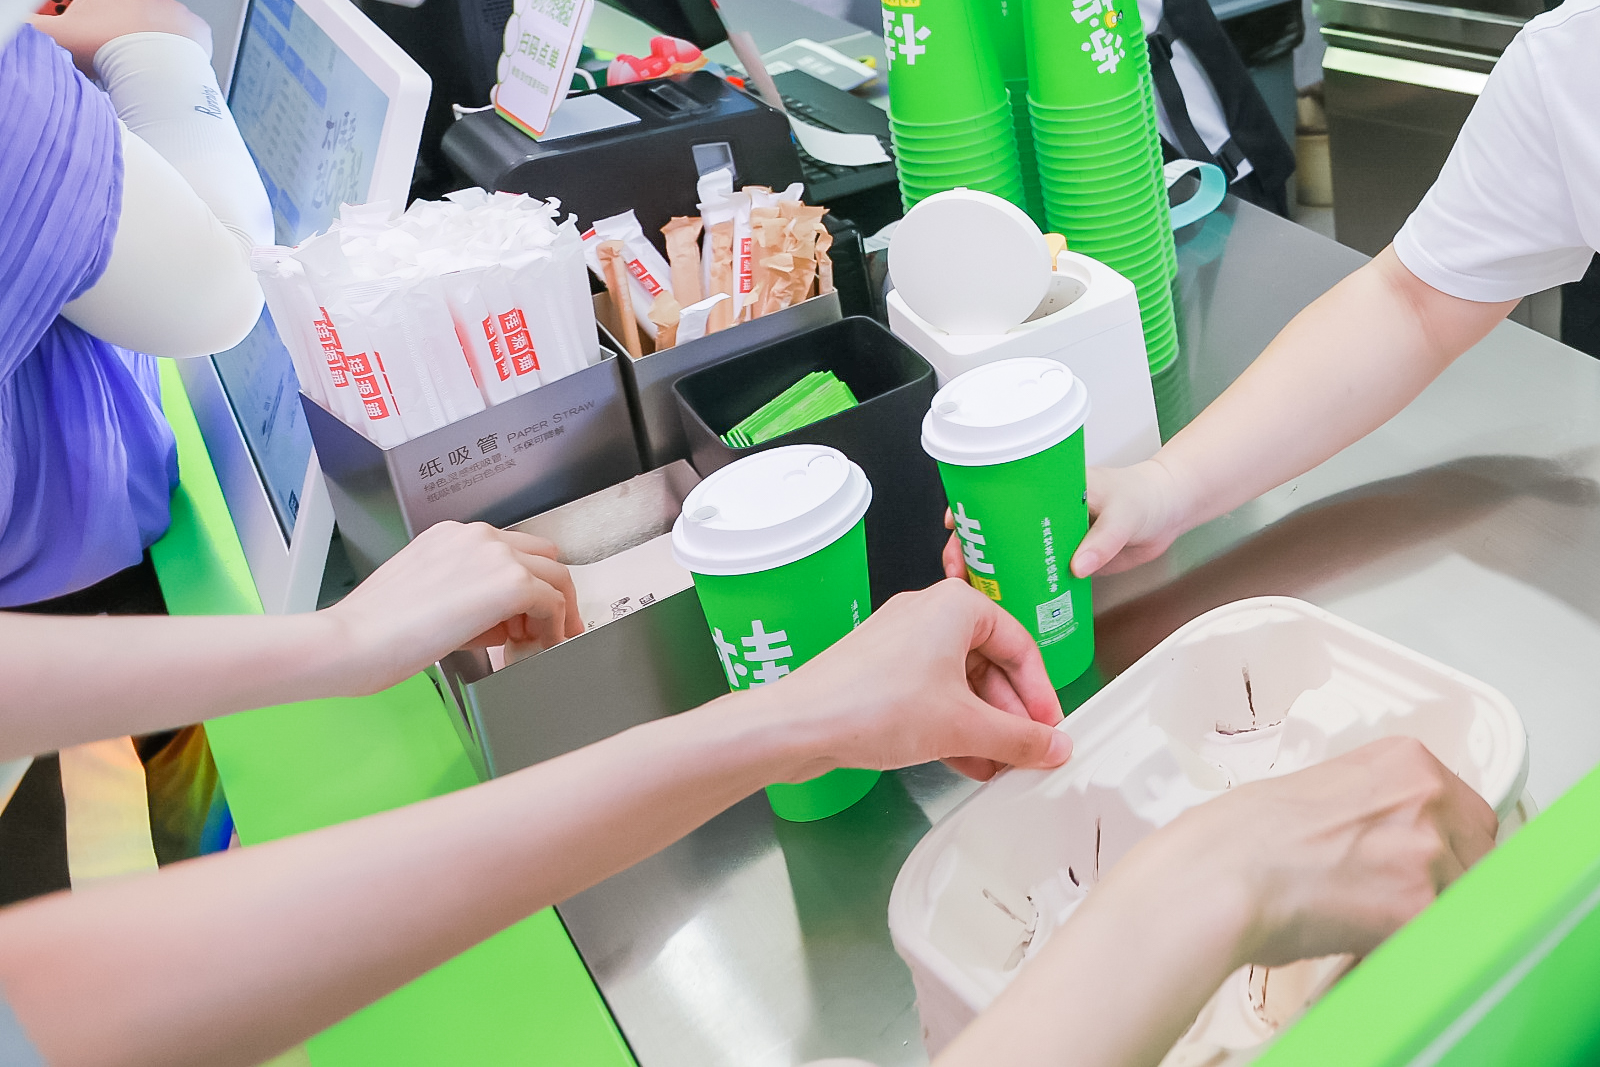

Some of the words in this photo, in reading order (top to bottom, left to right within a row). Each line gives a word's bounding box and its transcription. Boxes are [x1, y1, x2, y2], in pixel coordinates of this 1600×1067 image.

[506, 420, 548, 443] PAPER
[552, 400, 596, 423] STRAW
[418, 433, 498, 480] 纸吸管
